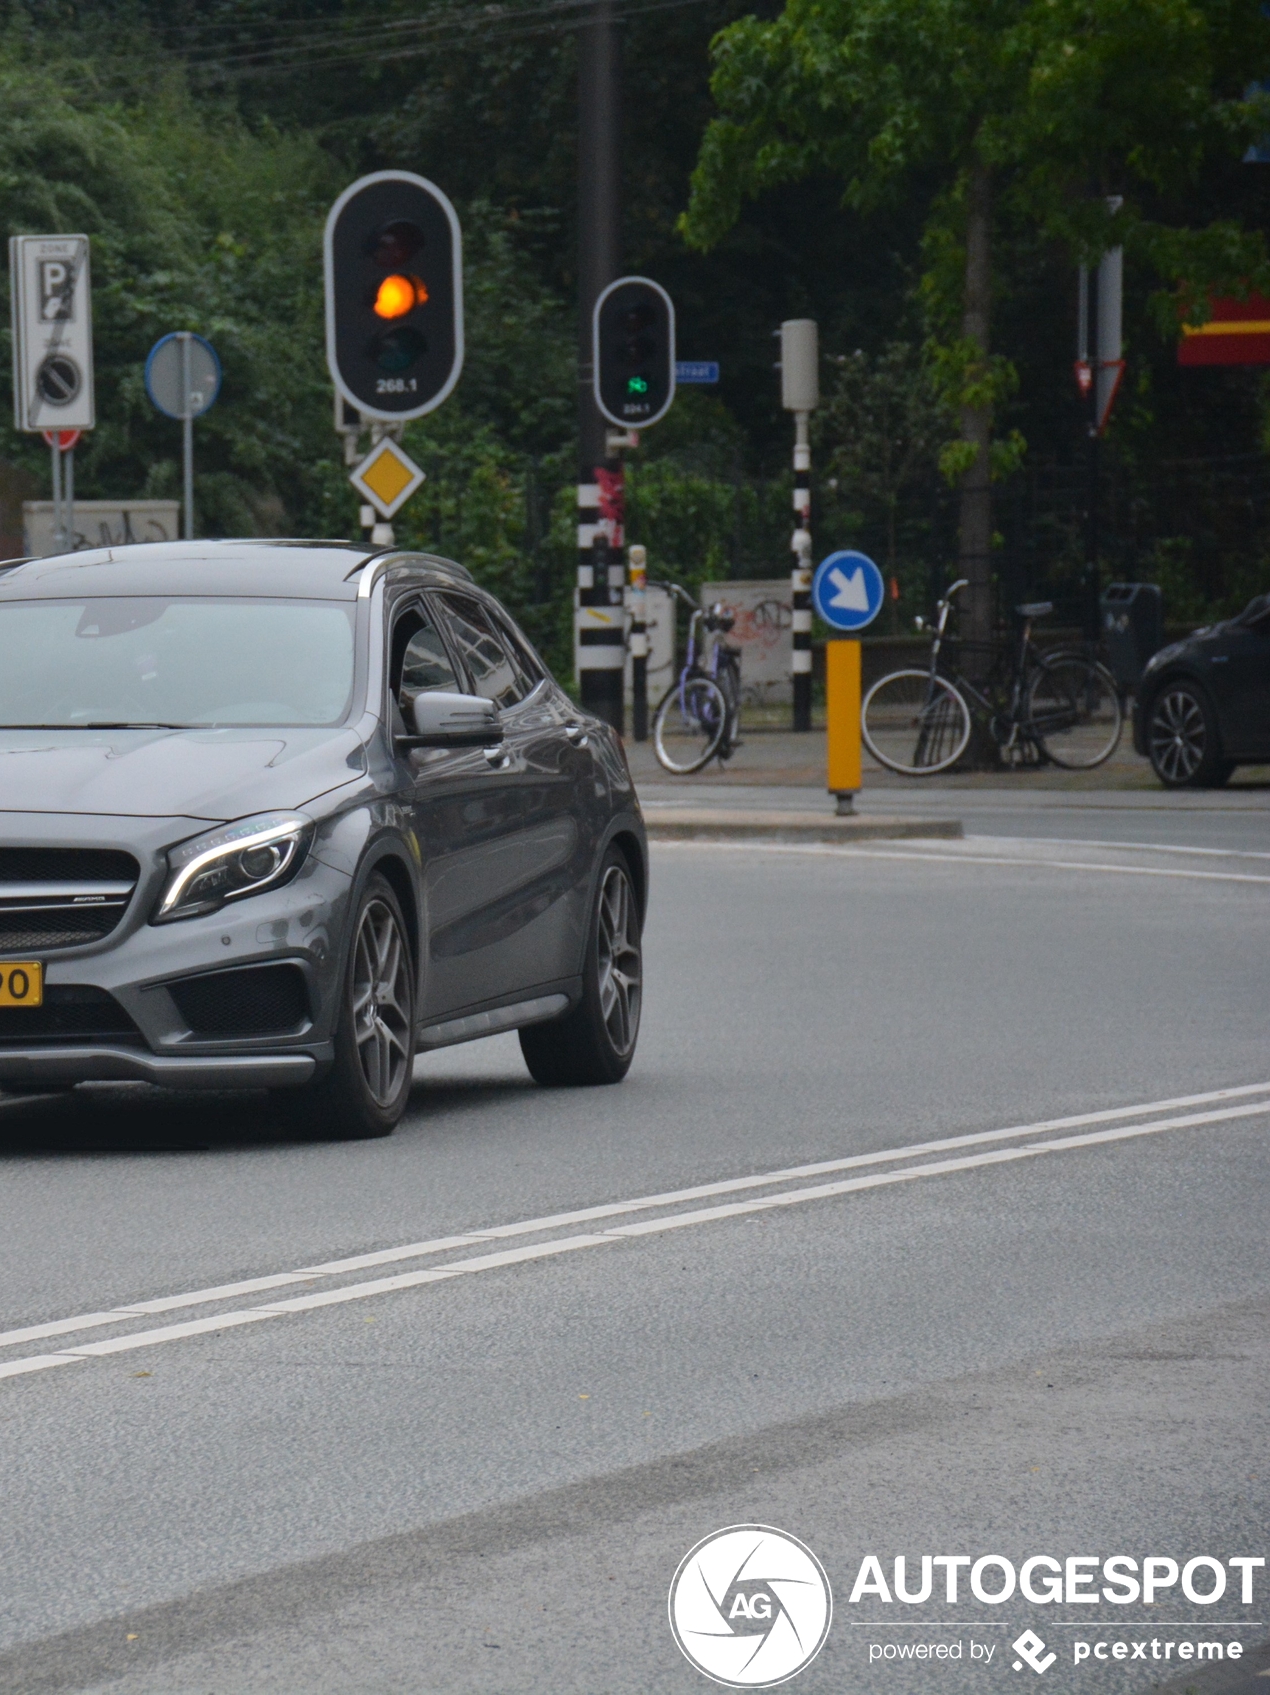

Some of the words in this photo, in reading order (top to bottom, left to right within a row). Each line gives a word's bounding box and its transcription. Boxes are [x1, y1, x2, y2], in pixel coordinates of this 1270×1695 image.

[43, 262, 66, 296] P
[673, 364, 710, 377] straat
[376, 378, 417, 393] 268.1
